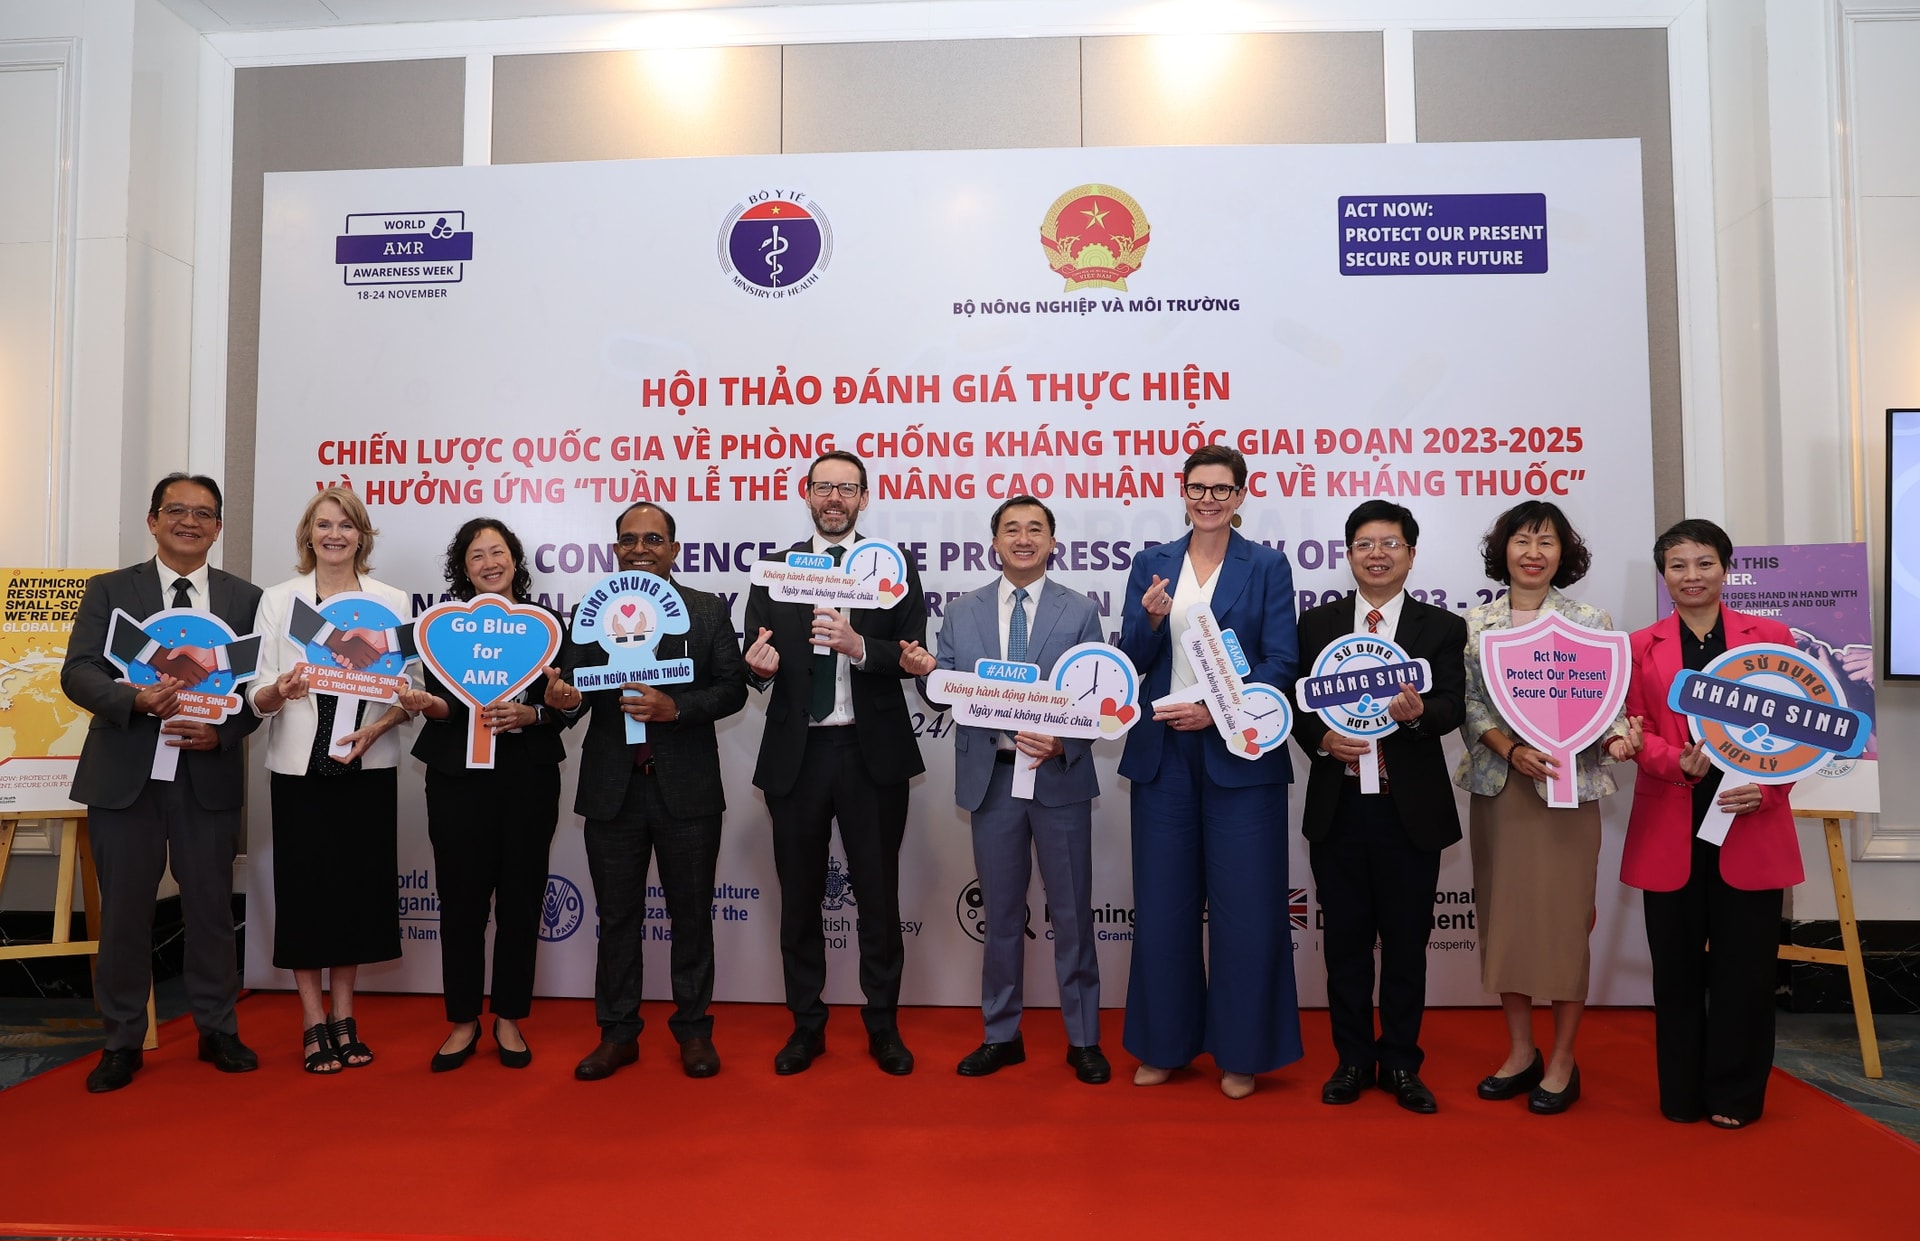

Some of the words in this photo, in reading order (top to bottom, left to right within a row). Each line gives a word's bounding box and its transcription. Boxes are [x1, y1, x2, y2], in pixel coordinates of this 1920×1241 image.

[775, 189, 784, 198] Y
[1344, 203, 1378, 218] ACT
[1382, 202, 1434, 217] NOW:
[384, 220, 426, 230] WORLD
[1345, 227, 1422, 242] PROTECT
[1426, 226, 1465, 241] OUR
[1469, 225, 1544, 240] PRESENT
[382, 241, 424, 255] AMR
[1346, 252, 1410, 267] SECURE
[1415, 251, 1453, 266] OUR
[1457, 250, 1524, 265] FUTURE
[353, 267, 420, 278] AWARENESS
[423, 266, 454, 276] WEEK
[357, 290, 385, 300] 18-24
[388, 288, 447, 299] NOVEMBER
[731, 275, 771, 298] MINISTRY
[772, 290, 786, 299] OF
[787, 273, 819, 297] HEALTH
[953, 299, 976, 317] BỘ
[980, 299, 1031, 315] NÔNG
[1036, 298, 1097, 316] NGHIỆP
[1102, 296, 1125, 313] VÀ
[1129, 297, 1162, 312] MÔI
[1167, 295, 1240, 312] TRƯỜNG
[642, 370, 707, 416] HỘI
[719, 365, 822, 407] THẢO
[833, 367, 940, 404] ĐÁNH
[952, 366, 1017, 402] GIÁ
[1026, 371, 1130, 410] THỰC
[1143, 363, 1230, 409] HIỆN
[318, 431, 407, 465] CHIẾN
[417, 437, 503, 471] LƯỢC
[512, 428, 601, 468] QUỐC
[610, 435, 665, 462] GIA
[673, 426, 711, 460] VỀ
[856, 423, 974, 458] CHỐNG
[985, 423, 1103, 457] KHÁNG
[1113, 420, 1226, 455] THUỐC
[1237, 428, 1304, 456] GIAI
[1315, 428, 1413, 462] ĐOẠN
[1423, 426, 1583, 454] 2023-2025
[365, 470, 483, 505] HƯỞNG
[493, 472, 565, 504] ỨNG
[687, 465, 720, 501] LỄ
[729, 466, 792, 501] THẾ
[878, 466, 975, 500] NÂNG
[986, 472, 1054, 499] CAO
[1065, 465, 1163, 506] NHẬN
[1276, 462, 1317, 497] VỀ
[1327, 463, 1445, 497] KHÁNG
[794, 556, 826, 568] #AMR
[1742, 557, 1779, 570] THIS
[763, 570, 786, 580] Không
[786, 572, 805, 581] hành
[806, 572, 824, 584] động
[825, 575, 841, 584] hôm
[842, 578, 856, 587] nay
[580, 589, 609, 627] CÙNG
[608, 576, 661, 597] CHUNG
[658, 592, 681, 618] TAY
[781, 585, 800, 596] Ngày
[800, 587, 814, 596] mai
[815, 588, 836, 600] không
[837, 589, 856, 600] thuốc
[856, 592, 874, 601] chữa
[1731, 591, 1756, 600] GOES
[1758, 591, 1786, 599] HAND
[1788, 591, 1798, 599] IN
[1800, 590, 1828, 599] HAND
[1831, 590, 1858, 598] WITH
[1731, 600, 1743, 608] OF
[1745, 600, 1789, 608] ANIMALS
[1792, 599, 1814, 607] AND
[1815, 599, 1836, 607] OUR
[2, 622, 59, 633] GLOBAL
[451, 617, 478, 633] Go
[483, 618, 527, 635] Blue
[472, 643, 503, 659] for
[1192, 639, 1204, 658] Ngày
[1225, 637, 1246, 668] #AMR
[1356, 643, 1393, 660] DỤNG
[1533, 650, 1550, 662] Act
[1553, 650, 1577, 662] Now
[1197, 614, 1212, 638] Không
[1207, 637, 1220, 657] hành
[1215, 656, 1228, 675] động
[1223, 674, 1235, 692] hôm
[1230, 691, 1241, 706] nay
[1200, 658, 1213, 673] mai
[462, 669, 509, 686] AMR
[577, 673, 601, 688] NGĂN
[603, 670, 628, 684] NGỪA
[629, 668, 659, 682] KHÁNG
[661, 662, 691, 677] THUỐC
[986, 664, 1027, 680] #AMR
[1506, 668, 1544, 680] Protect
[1546, 668, 1565, 680] Our
[1568, 669, 1607, 680] Present
[1743, 654, 1769, 672] SỬ
[1777, 660, 1826, 697] DỤNG
[378, 677, 399, 687] SINH
[1206, 670, 1220, 694] không
[1311, 674, 1370, 697] KHÁNG
[1375, 667, 1419, 686] SINH
[944, 682, 974, 697] Không
[975, 685, 1000, 698] hành
[1002, 688, 1025, 703] động
[1027, 691, 1048, 703] hôm
[1051, 696, 1069, 707] nay
[1512, 686, 1546, 698] Secure
[1549, 687, 1567, 698] Our
[1571, 687, 1603, 699] Future
[205, 696, 228, 707] SINH
[1215, 692, 1231, 714] thuốc
[1691, 680, 1776, 717] KHÁNG
[1785, 705, 1850, 737] SINH
[968, 703, 993, 718] Ngày
[994, 707, 1013, 718] mai
[1013, 708, 1041, 724] không
[1043, 711, 1069, 725] thuốc
[1070, 714, 1093, 727] chữa
[1346, 717, 1370, 731] HỢP
[1376, 715, 1388, 727] LÝ
[1718, 741, 1751, 763] HỢP
[1759, 757, 1778, 771] LÝ
[722, 905, 748, 920] the
[408, 926, 437, 940] Nam
[556, 913, 578, 936] PANIS
